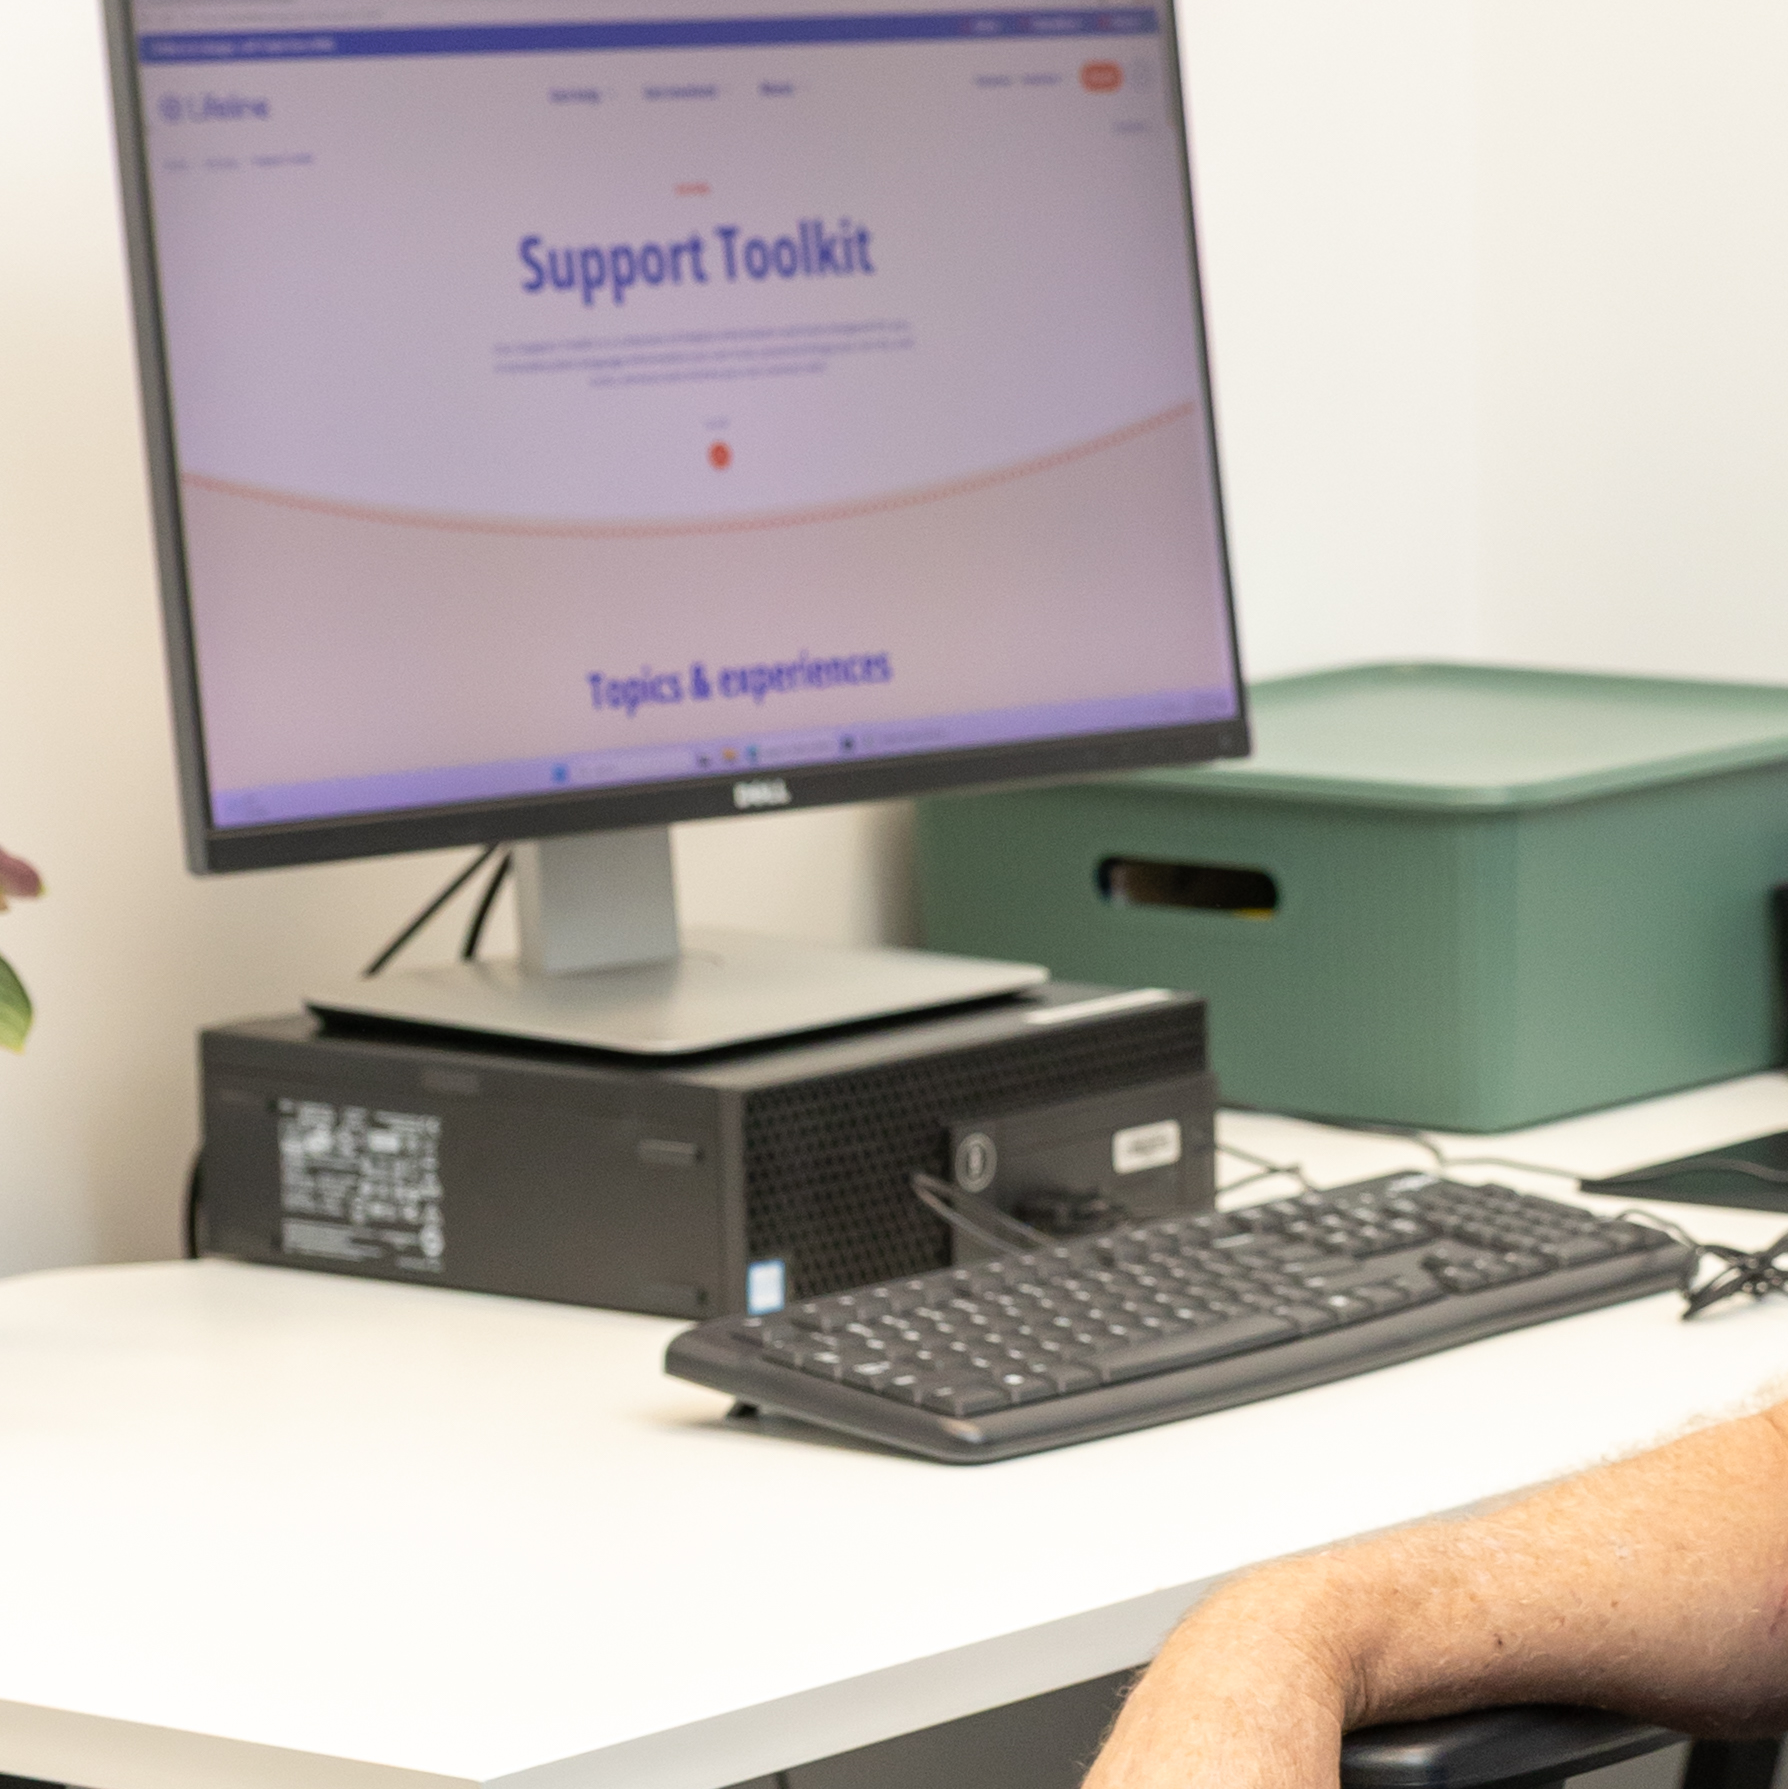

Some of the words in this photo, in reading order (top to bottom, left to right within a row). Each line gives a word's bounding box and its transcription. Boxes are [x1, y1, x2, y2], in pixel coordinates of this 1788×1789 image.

[518, 233, 707, 307] Support
[712, 216, 876, 282] Toolkit
[587, 664, 684, 718] Topics
[690, 661, 712, 701] &
[717, 650, 892, 705] experiences
